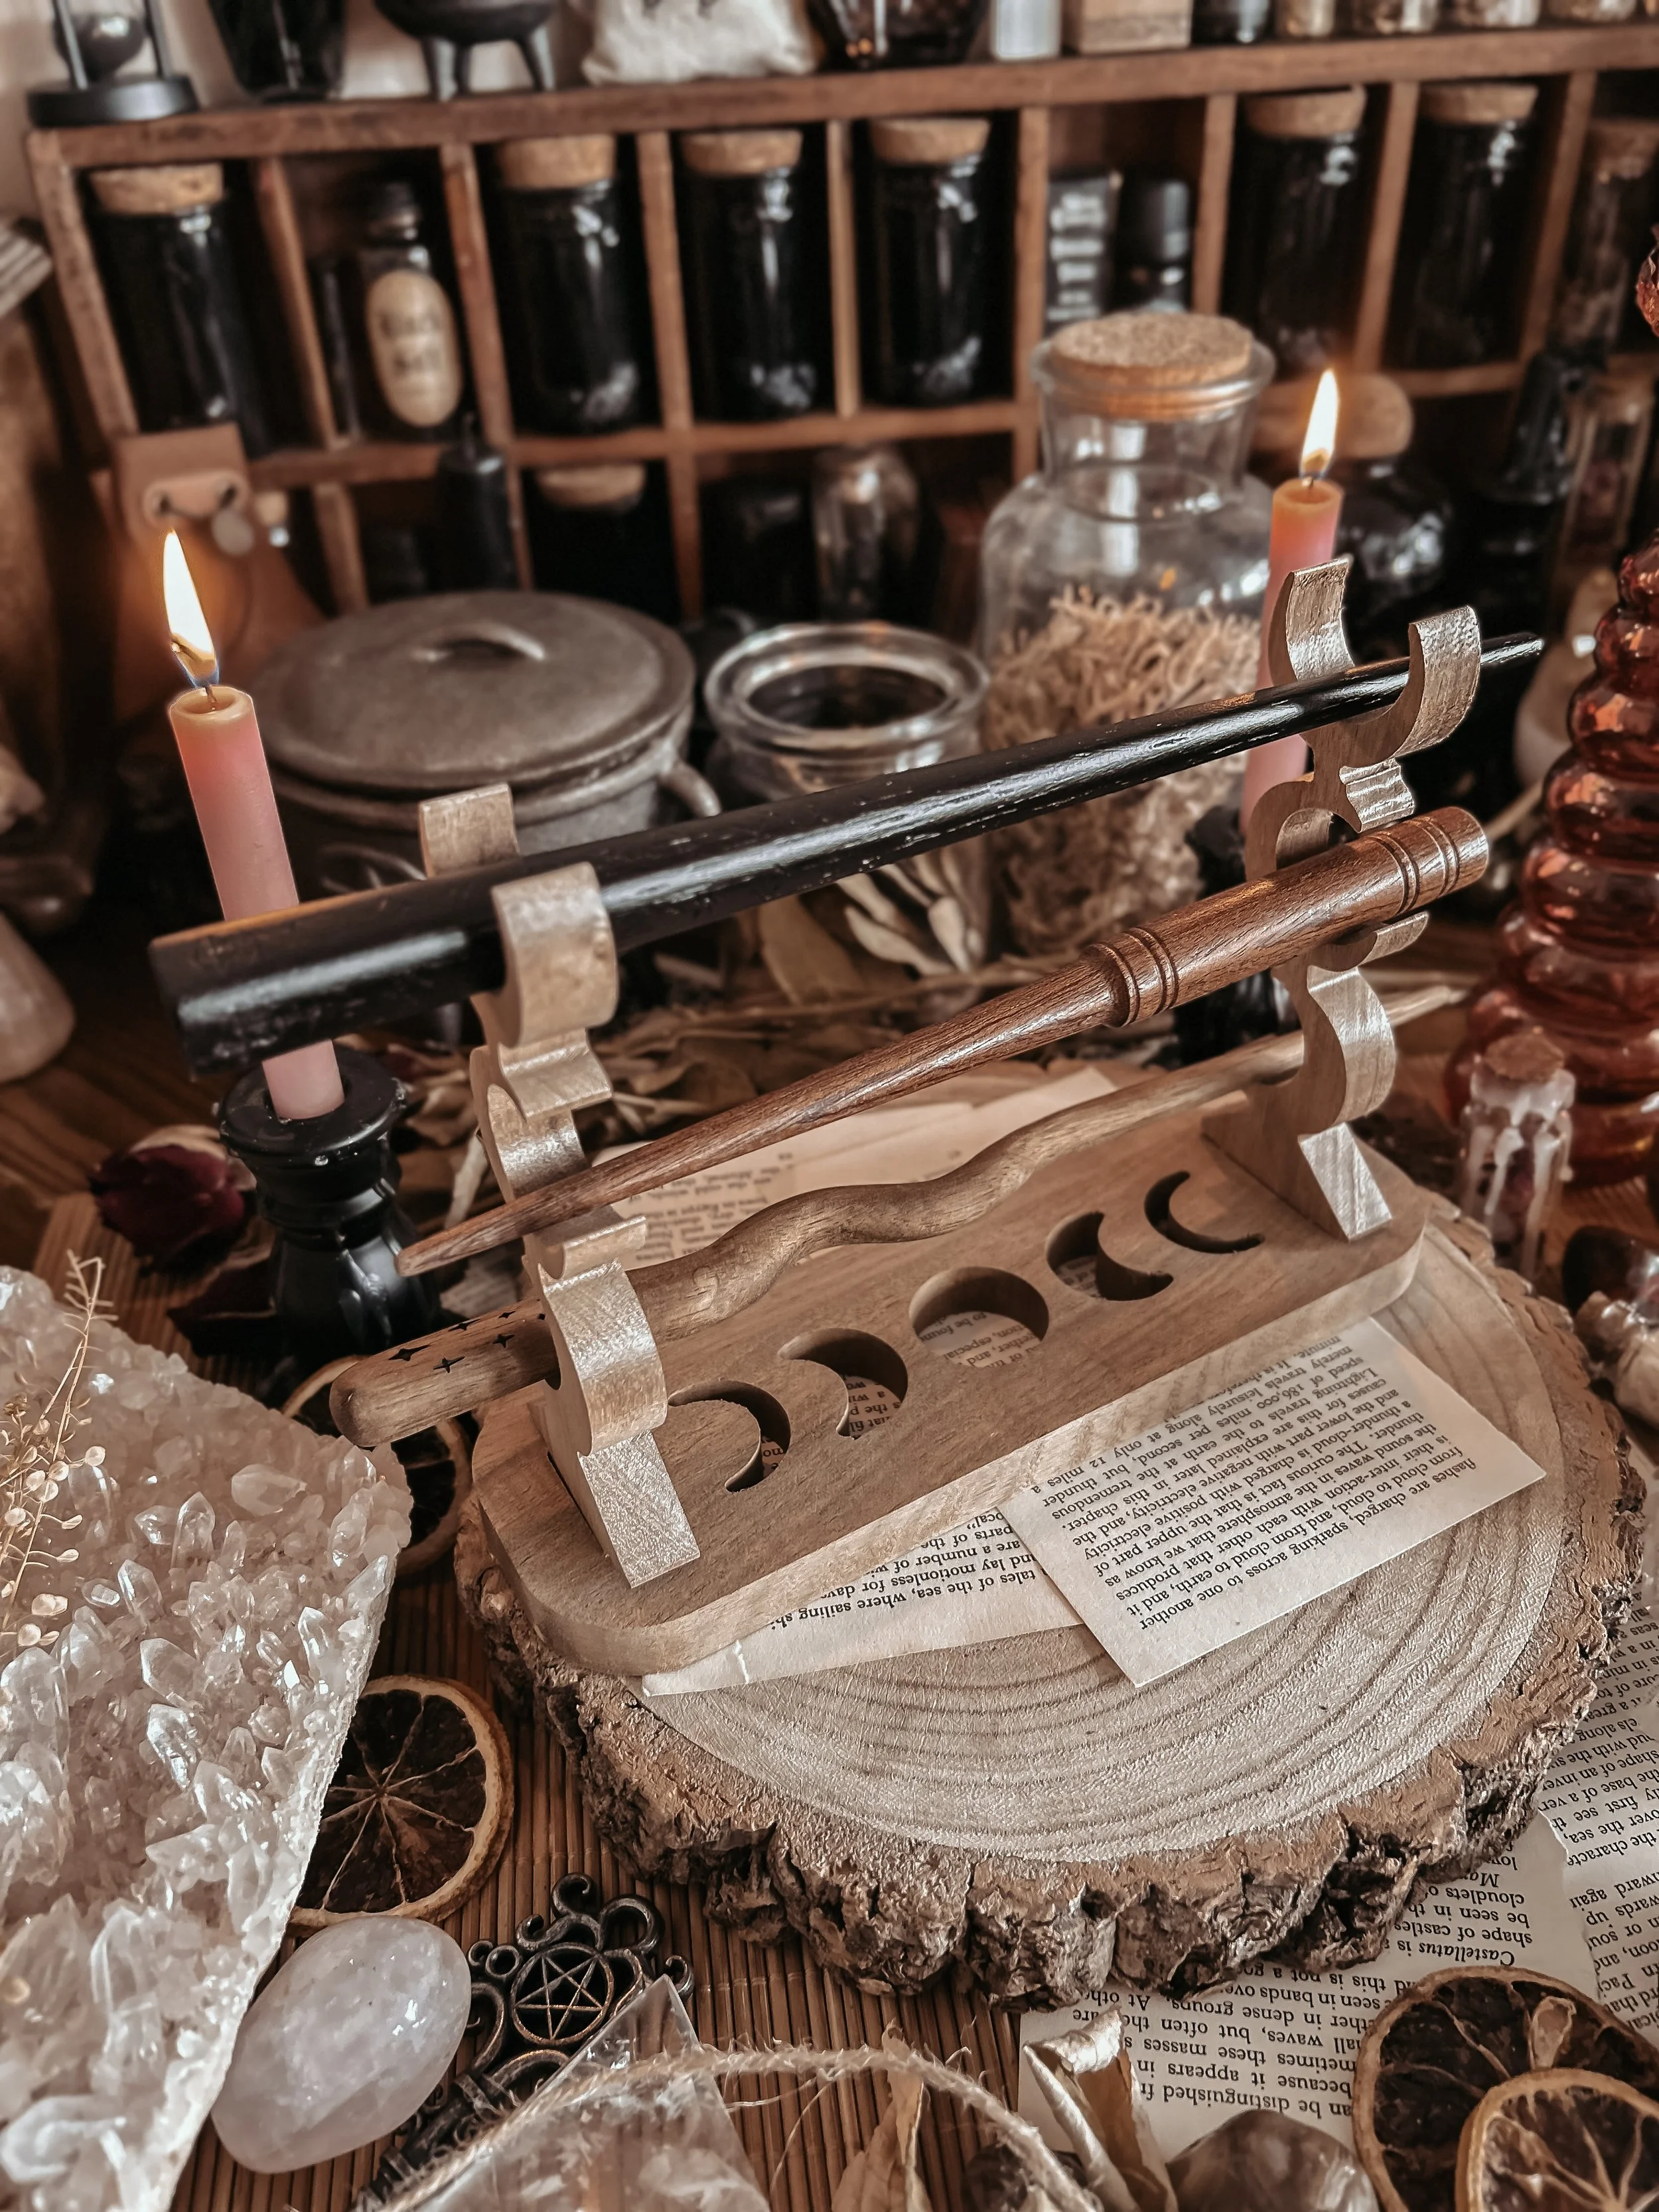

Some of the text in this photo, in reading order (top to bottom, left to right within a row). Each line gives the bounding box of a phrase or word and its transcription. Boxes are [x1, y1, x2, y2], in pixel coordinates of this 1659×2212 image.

[863, 1403, 888, 1415] the
[1041, 1357, 1364, 1507] speed of 186,000 miles per second, but thunder
[1050, 1366, 1378, 1520] Lightning travels to the earth at the tremendous
[1061, 1378, 1386, 1532] causes for this are explained later in this chapter.
[1072, 1388, 1399, 1546] and the lower part with negative electricity, and the
[1084, 1400, 1411, 1560] a thunder-cloud is charged with positive electricity
[1092, 1412, 1424, 1578] thunder. The curious fact is that the upper part of
[1104, 1423, 1437, 1587] the sound waves in the atmosphere that we know as
[1115, 1434, 1451, 1601] is their inter-action with each other that produces
[1125, 1445, 1463, 1616] from cloud to cloud, and from cloud to earth, and it
[951, 1522, 1013, 1548] parts of
[1138, 1457, 1477, 1630] flashes are charged, sparking across to one another
[893, 1539, 1021, 1574] are a number of
[861, 1558, 1006, 1593] lay motionless for
[797, 1569, 1036, 1620] tales of the sea, where sailing
[1573, 1723, 1617, 1741] along
[1565, 1739, 1628, 1764] with the
[1577, 1761, 1616, 1779] of an
[1567, 1776, 1638, 1804] base of a
[1572, 1795, 1638, 1822] first see
[1597, 1820, 1624, 1835] the
[1629, 1831, 1657, 1847] the
[1445, 1886, 1525, 1909] cloudlets
[1432, 1904, 1530, 1929] be seen in
[1585, 1910, 1609, 1925] up
[1456, 1926, 1533, 1949] shape of
[1623, 1923, 1642, 1937] or
[1396, 1939, 1515, 1964] Castellatus is
[1329, 1972, 1386, 1994] this is
[1127, 1993, 1151, 2011] At
[1259, 1986, 1380, 2010] seen in bands
[1242, 2006, 1295, 2027] dense
[1303, 2012, 1322, 2030] in
[1161, 2018, 1323, 2047] waves, but often
[1143, 2037, 1266, 2067] these masses
[1136, 2059, 1351, 2100] because it appears in
[1298, 2099, 1322, 2119] be
